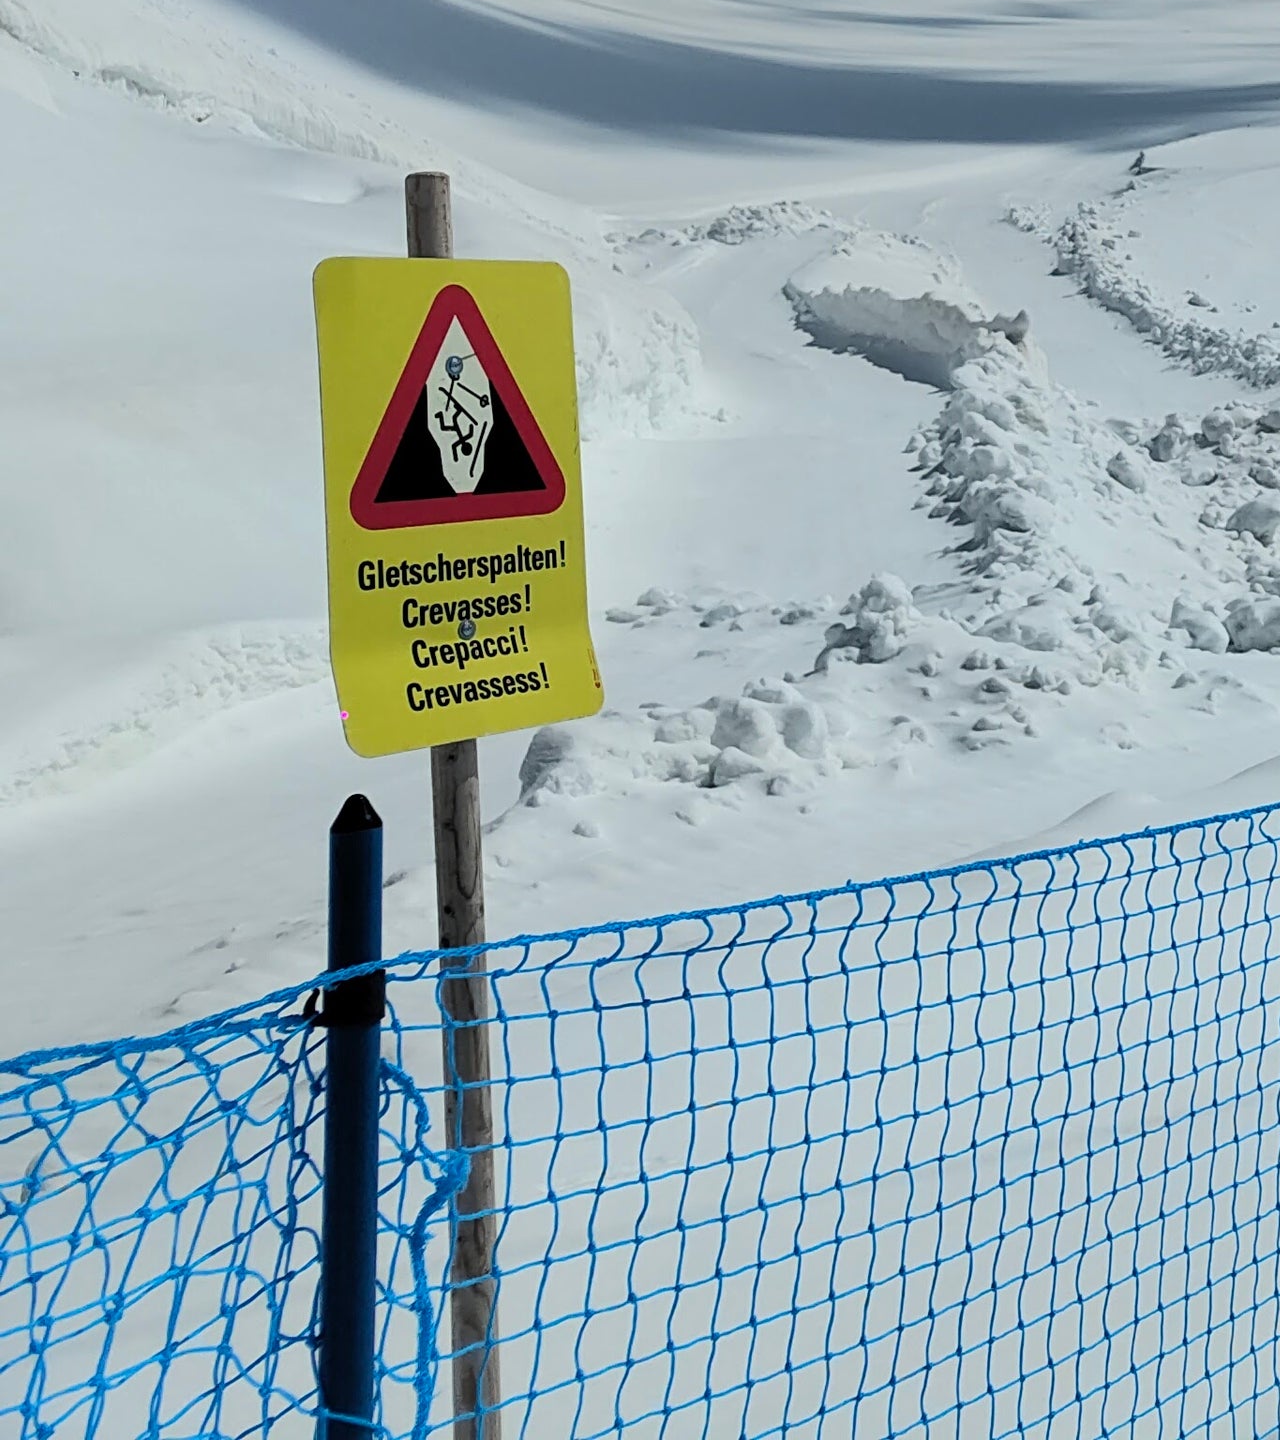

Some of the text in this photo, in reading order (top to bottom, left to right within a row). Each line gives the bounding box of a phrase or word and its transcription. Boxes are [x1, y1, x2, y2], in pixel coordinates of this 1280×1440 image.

[358, 540, 566, 591] Gletscherspalten!
[402, 584, 531, 628] Crevasses!
[412, 625, 529, 669] Crepacci!
[406, 662, 550, 712] Crevassess!
